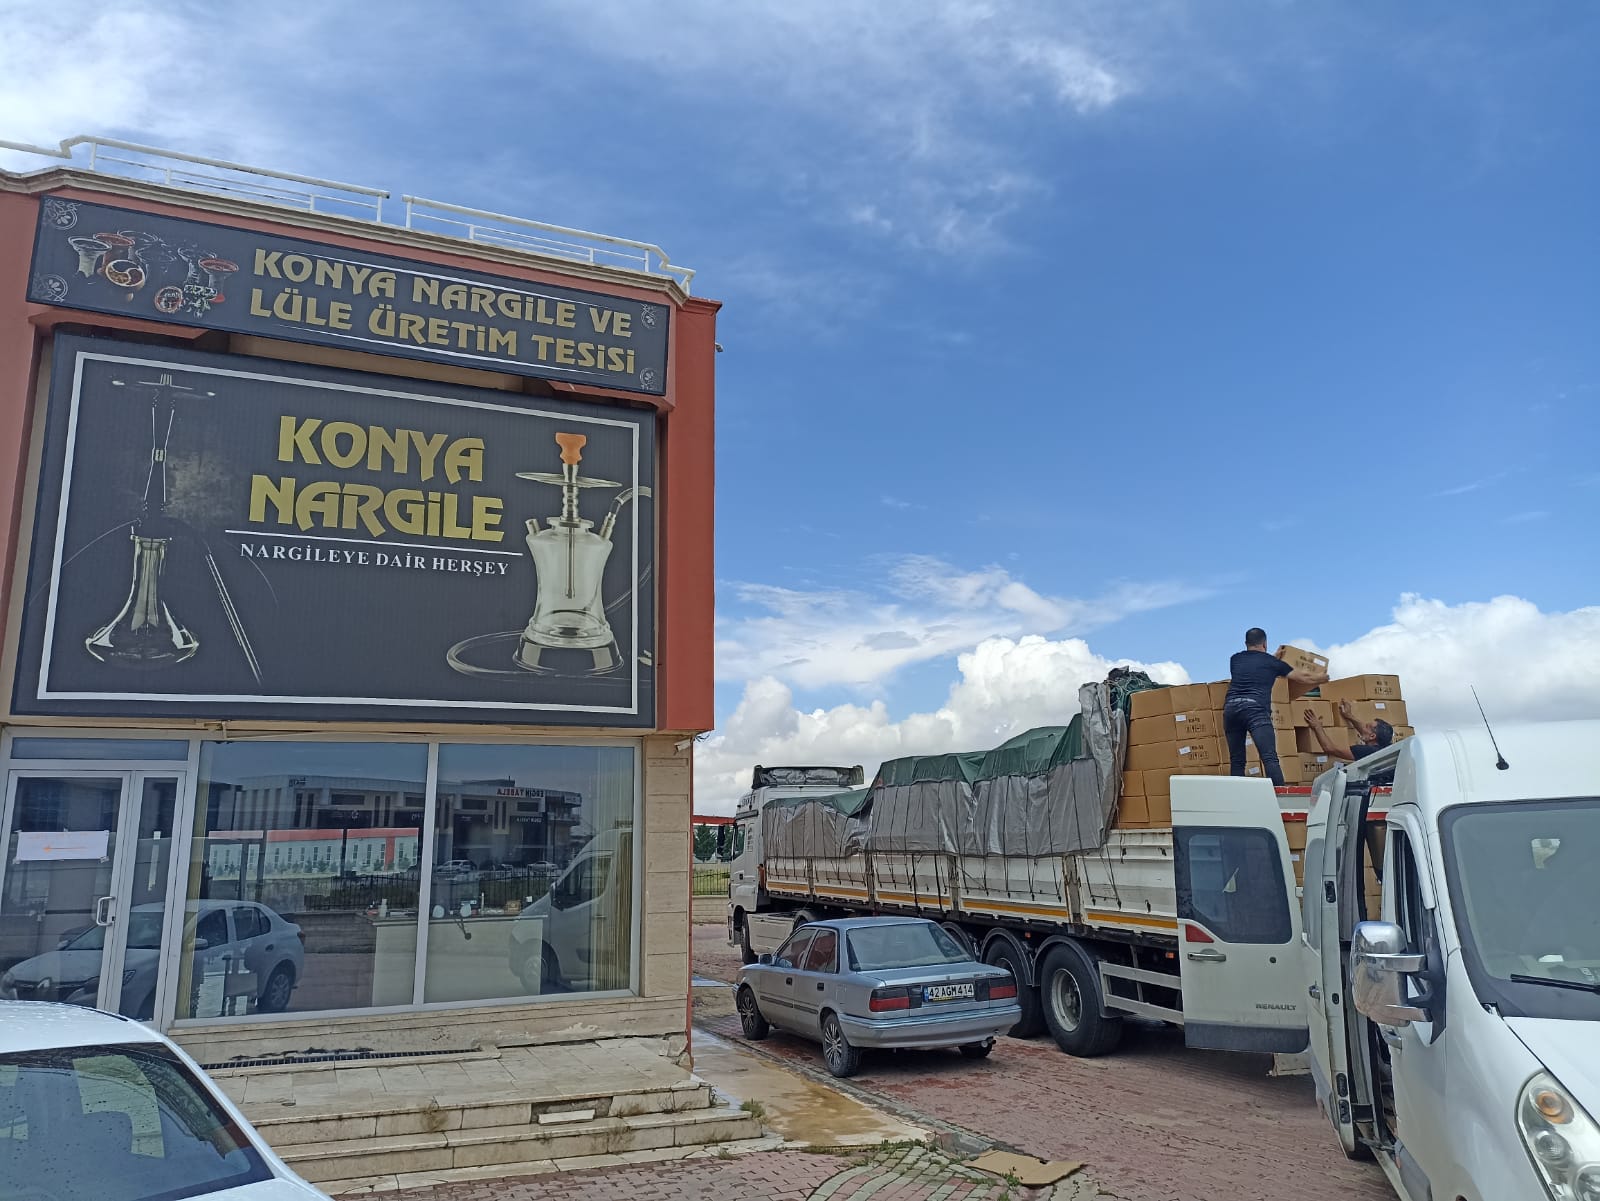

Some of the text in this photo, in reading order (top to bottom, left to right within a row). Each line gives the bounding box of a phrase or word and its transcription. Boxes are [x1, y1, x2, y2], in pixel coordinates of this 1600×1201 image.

[250, 288, 353, 330] LÜLE
[254, 249, 397, 298] KONYA
[589, 307, 632, 338] VE
[278, 415, 485, 485] KONYA
[240, 543, 509, 577] NARGİLEYE DAİR HERŞEY
[929, 987, 940, 998] 42
